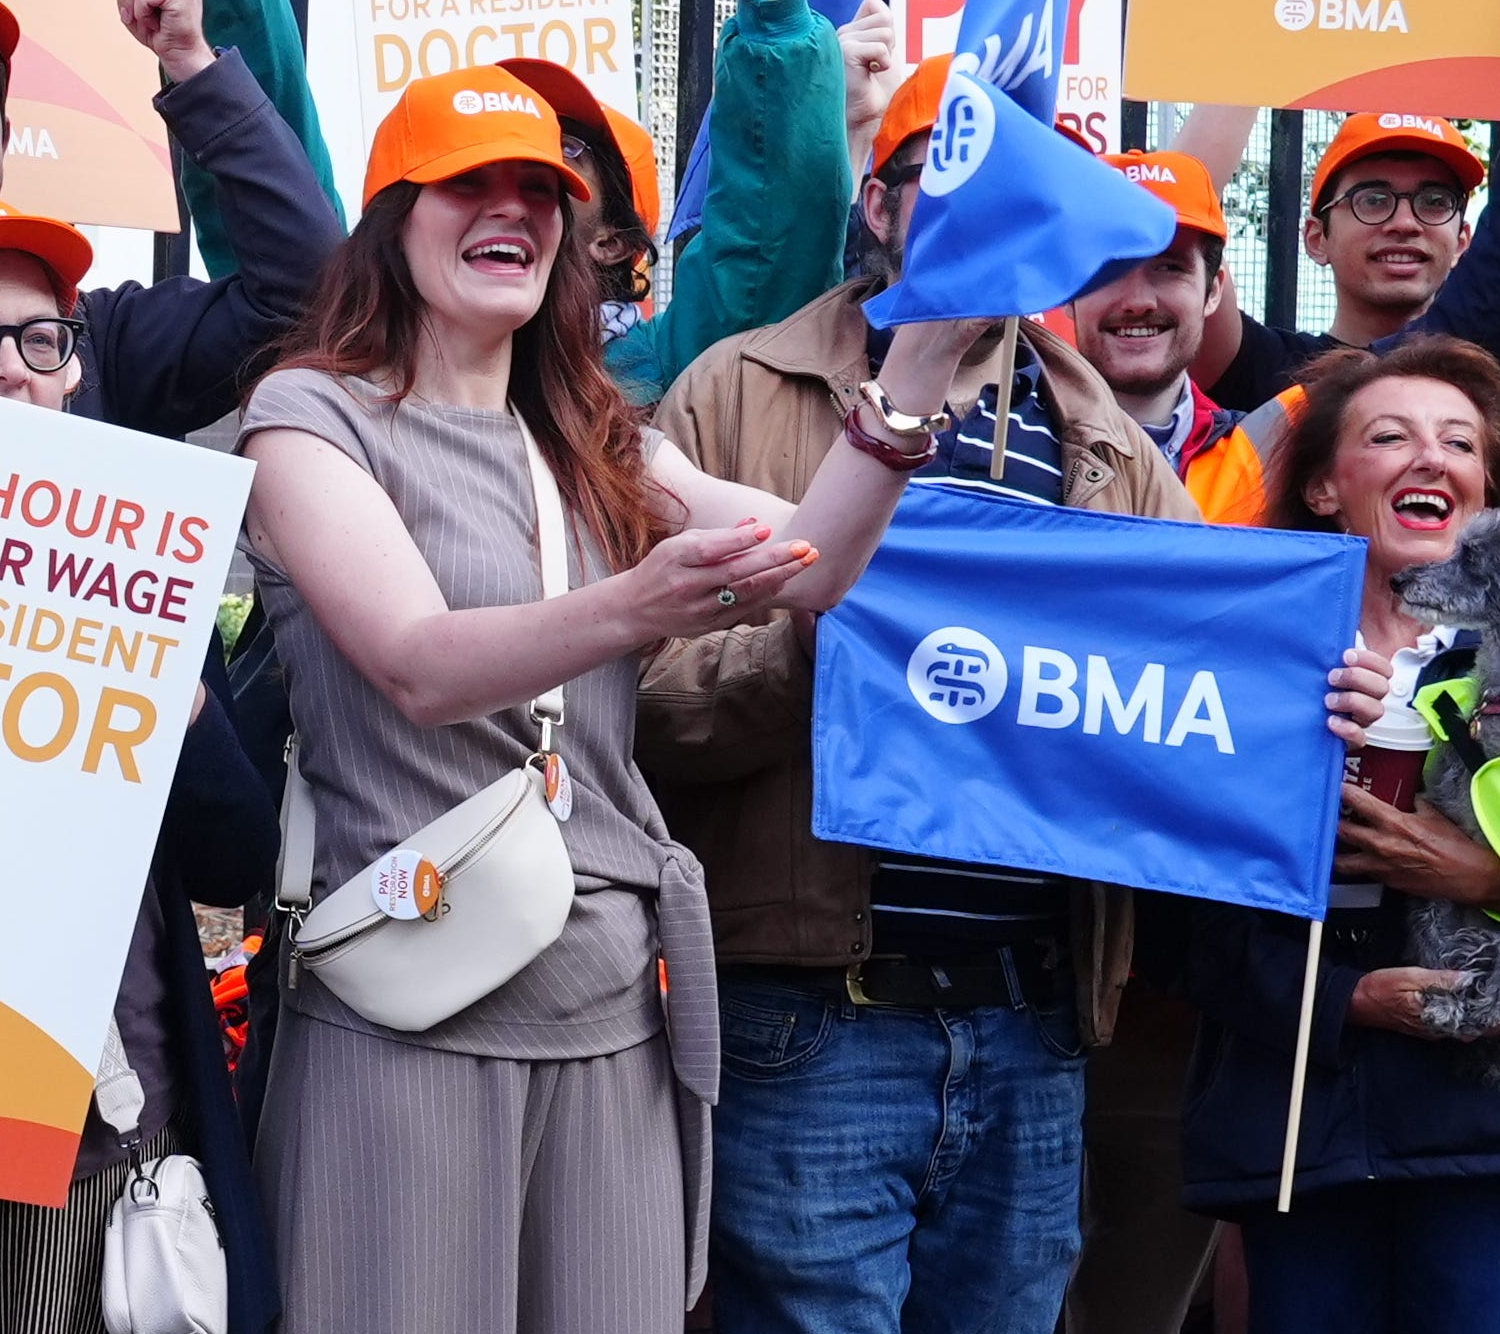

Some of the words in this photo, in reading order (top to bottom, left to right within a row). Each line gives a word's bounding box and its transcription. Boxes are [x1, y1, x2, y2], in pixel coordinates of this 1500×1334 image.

[374, 18, 618, 92] DOCTOR
[483, 92, 541, 119] BMA
[1403, 115, 1444, 139] BMA
[1127, 164, 1176, 183] BMA
[156, 512, 209, 563] IS
[48, 549, 193, 623] WAGE
[1017, 646, 1235, 754] BMA
[379, 871, 390, 895] PAY
[398, 869, 409, 899] NOW
